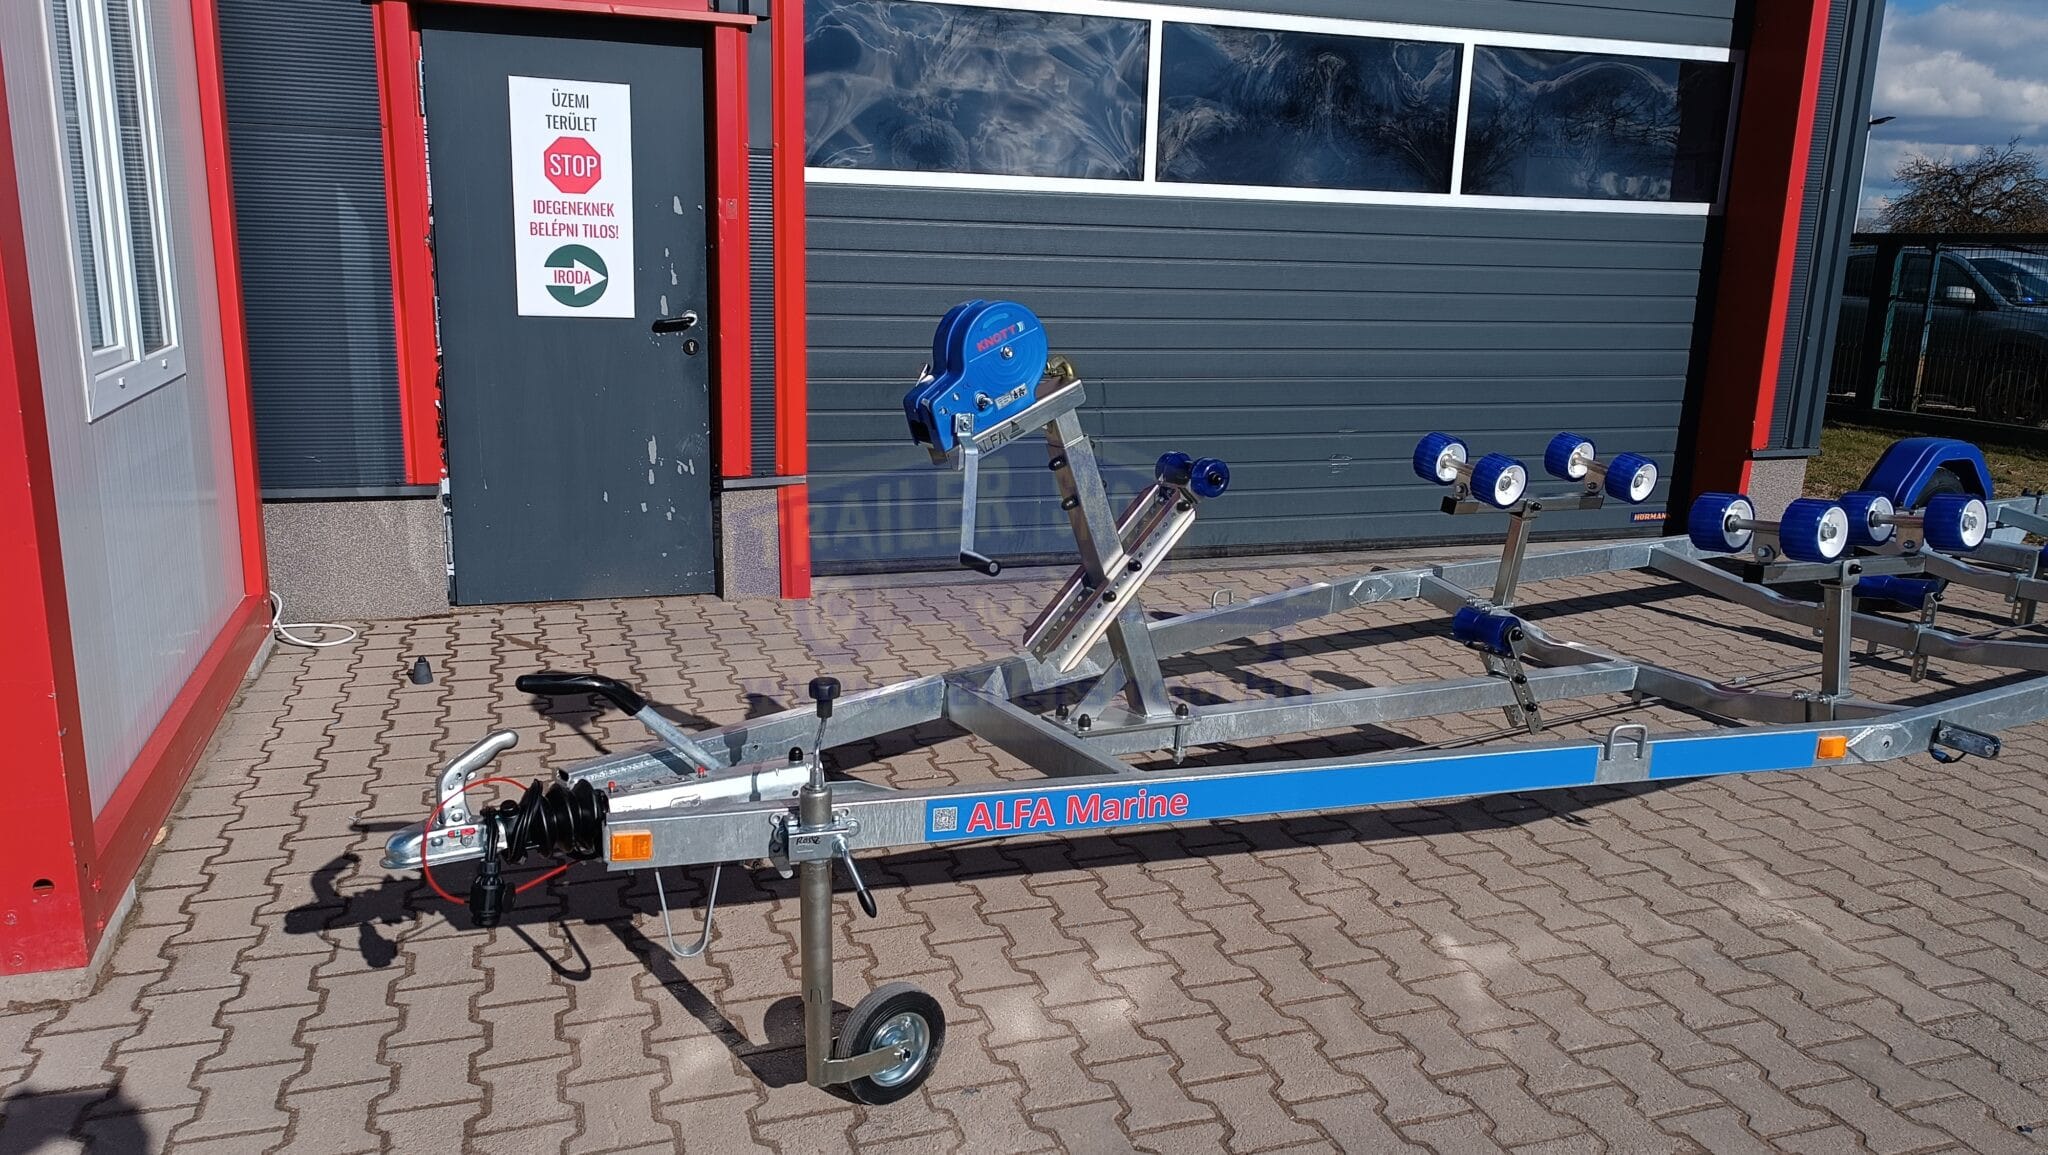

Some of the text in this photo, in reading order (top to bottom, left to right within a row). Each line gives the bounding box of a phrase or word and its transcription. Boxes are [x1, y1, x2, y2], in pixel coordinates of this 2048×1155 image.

[545, 112, 597, 132] TERÜLET
[549, 153, 598, 178] STOP
[533, 200, 615, 217] IDEGENEKNEK
[529, 219, 619, 239] BELÉPNI TILOS!
[553, 269, 592, 285] IRODA
[977, 325, 1016, 351] KNOTT
[976, 431, 1009, 454] ALFA
[966, 788, 1190, 833] ALFA Marine
